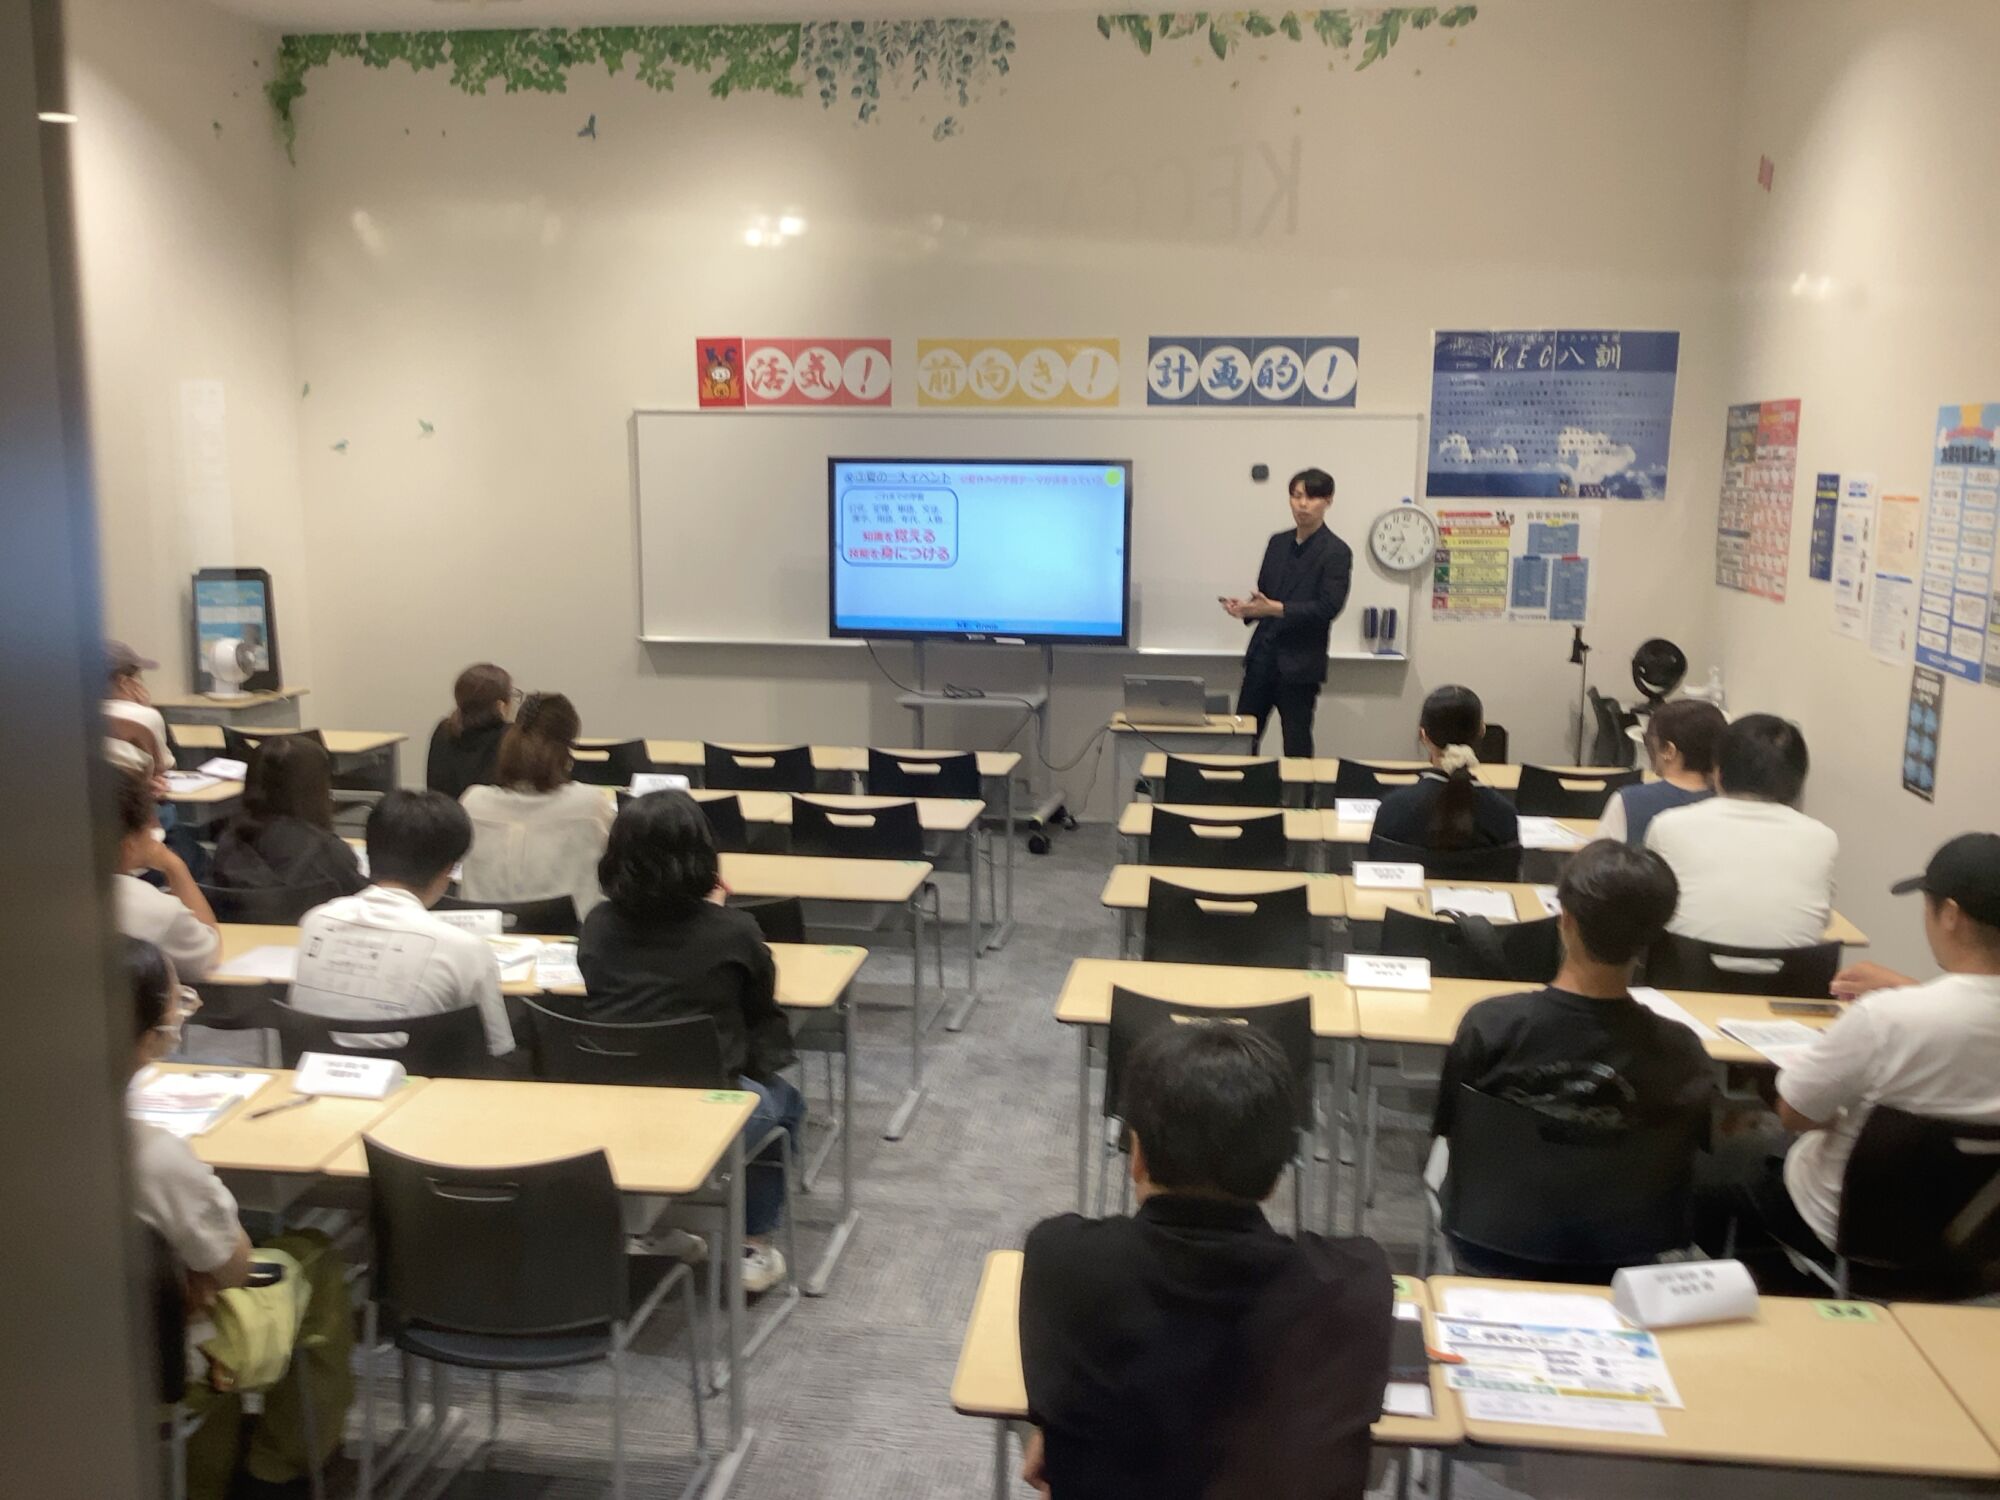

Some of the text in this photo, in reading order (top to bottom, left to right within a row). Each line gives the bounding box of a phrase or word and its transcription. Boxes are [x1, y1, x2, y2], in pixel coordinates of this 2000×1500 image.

[750, 351, 873, 394] 活気！
[924, 354, 1099, 394] 前向き！
[1155, 353, 1338, 394] 計画的！
